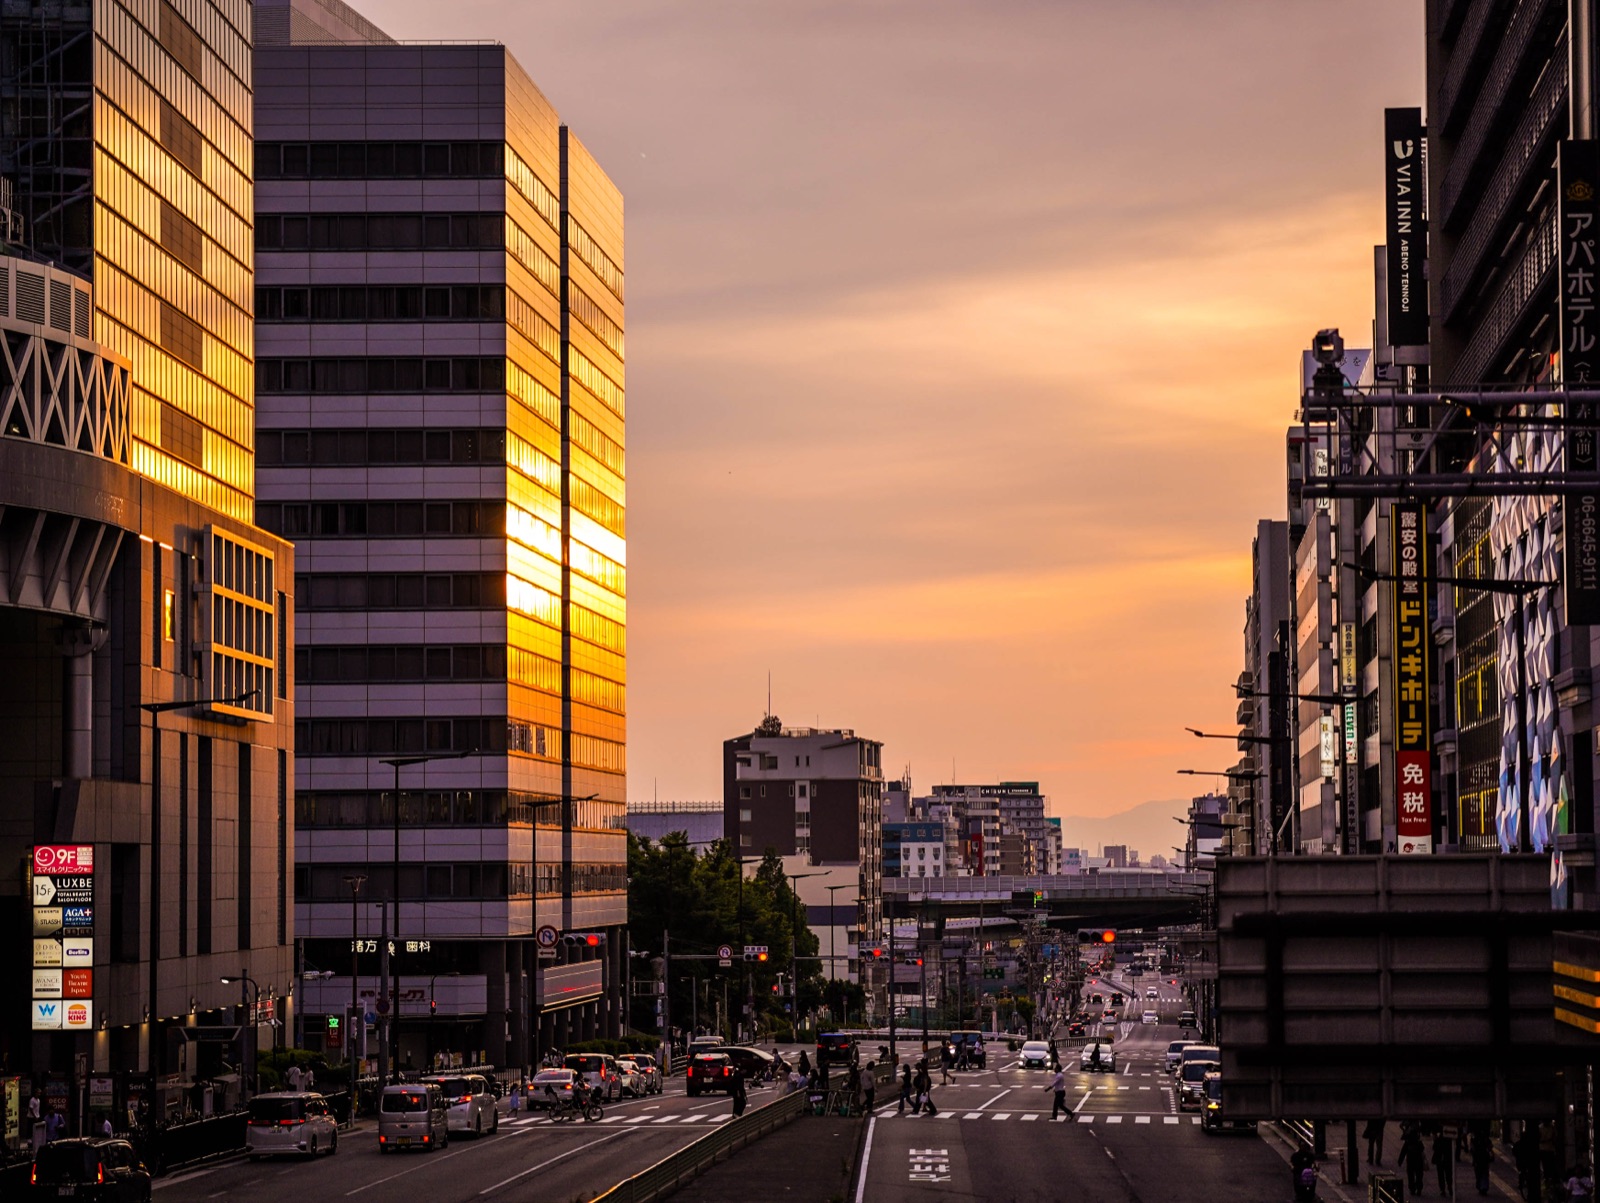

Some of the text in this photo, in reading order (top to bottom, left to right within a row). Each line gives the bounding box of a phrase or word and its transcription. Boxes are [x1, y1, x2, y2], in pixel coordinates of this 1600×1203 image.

[1396, 164, 1412, 312] VIA INN ABENO TENNOJI
[1566, 212, 1596, 353] アパホテル
[1401, 512, 1418, 593] 驚安の殿堂
[1581, 495, 1597, 590] 06-6645-9111
[1403, 763, 1425, 814] 免税
[56, 848, 76, 865] 9F
[35, 884, 51, 896] 15F
[56, 878, 92, 888] LUXBE
[65, 909, 84, 917] AGA
[406, 940, 431, 953] 歯科
